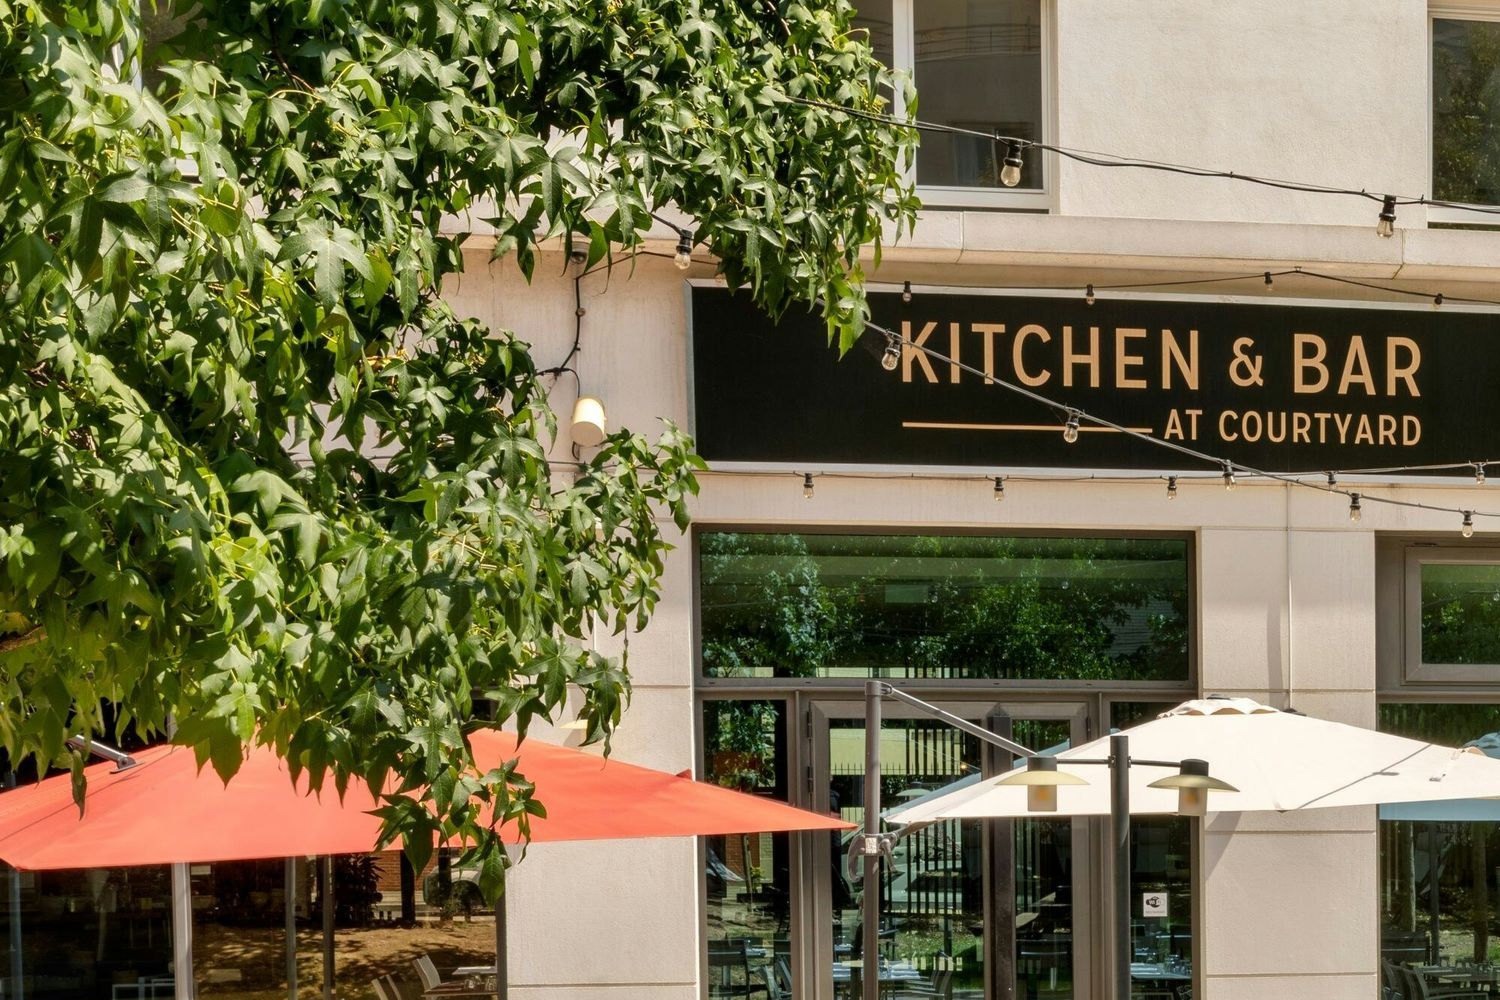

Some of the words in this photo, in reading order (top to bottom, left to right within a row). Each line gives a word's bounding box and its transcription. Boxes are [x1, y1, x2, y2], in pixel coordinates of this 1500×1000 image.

[901, 320, 1199, 391] KITCHEN
[1228, 336, 1264, 388] &
[1293, 333, 1422, 397] BAR
[1163, 408, 1203, 441] AT
[1218, 409, 1422, 446] COURTYARD
